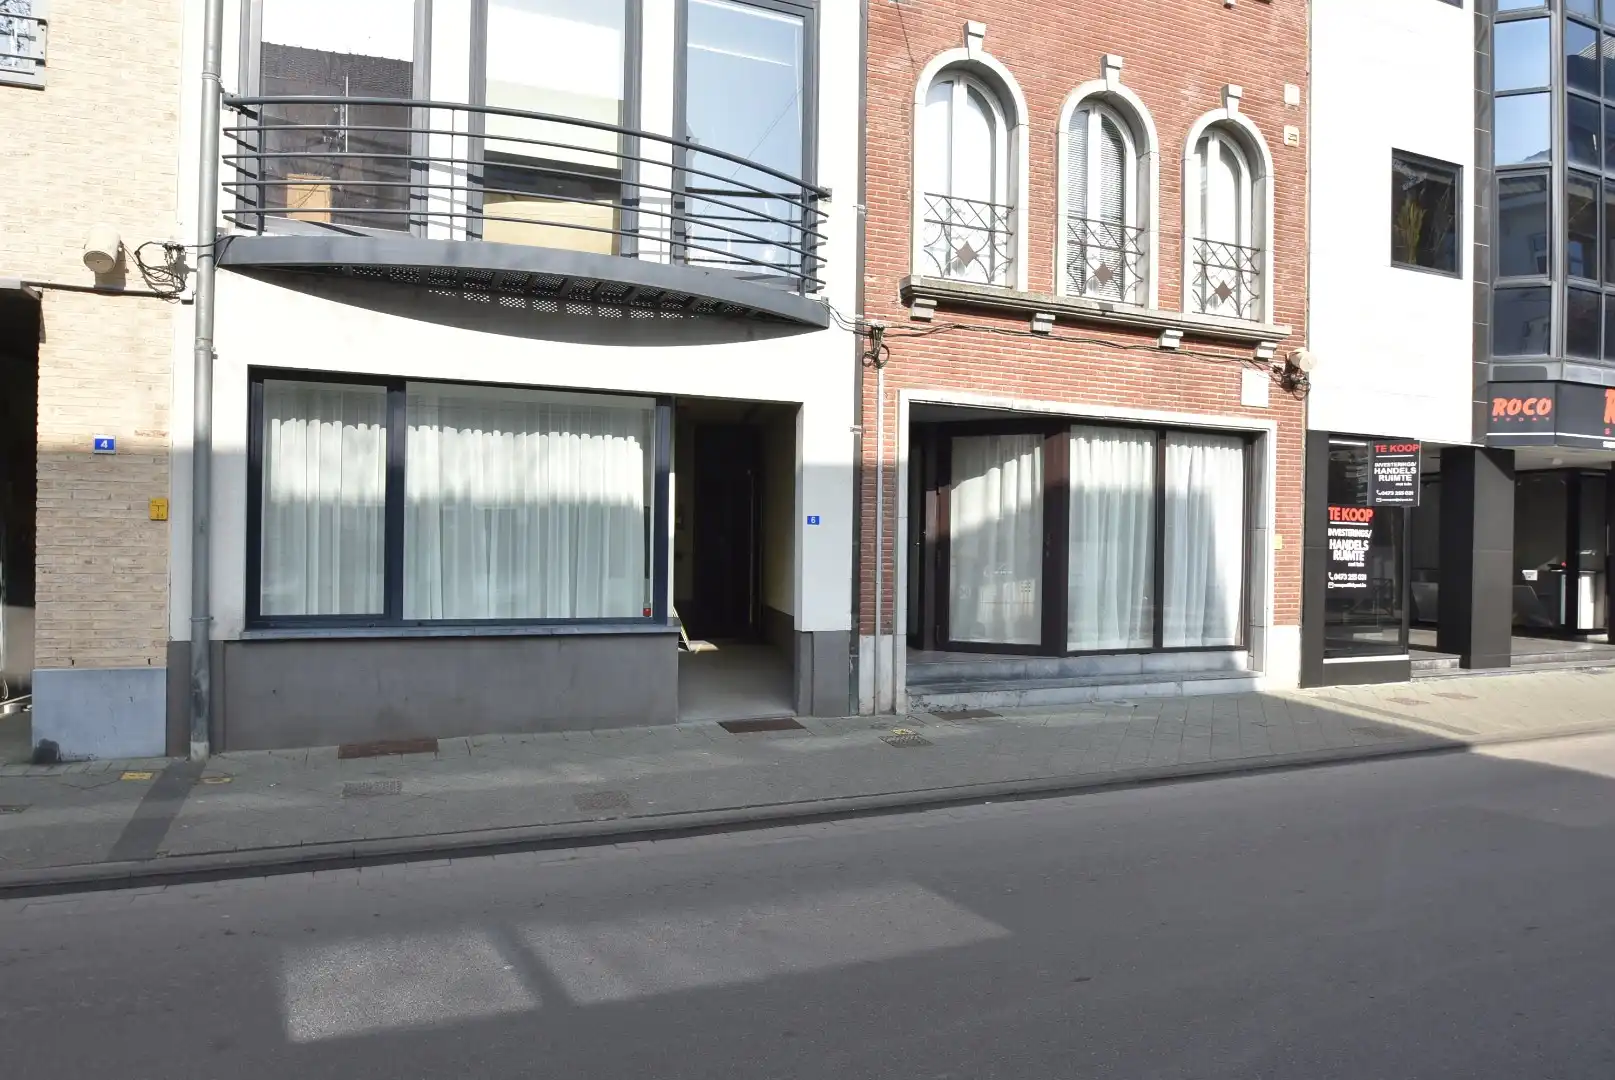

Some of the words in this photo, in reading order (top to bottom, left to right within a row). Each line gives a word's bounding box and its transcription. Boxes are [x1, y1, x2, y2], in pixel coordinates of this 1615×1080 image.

[1492, 397, 1552, 416] ROCO
[100, 440, 108, 448] 4
[1375, 444, 1387, 453] TE
[1389, 443, 1419, 453] KOOP
[1374, 467, 1417, 475] HANDELS
[1378, 474, 1413, 482] RUIMTE
[1328, 506, 1340, 521] TE
[1341, 508, 1374, 522] KOOP
[1328, 539, 1370, 551] HANDELS
[1333, 550, 1365, 561] RUIMTE
